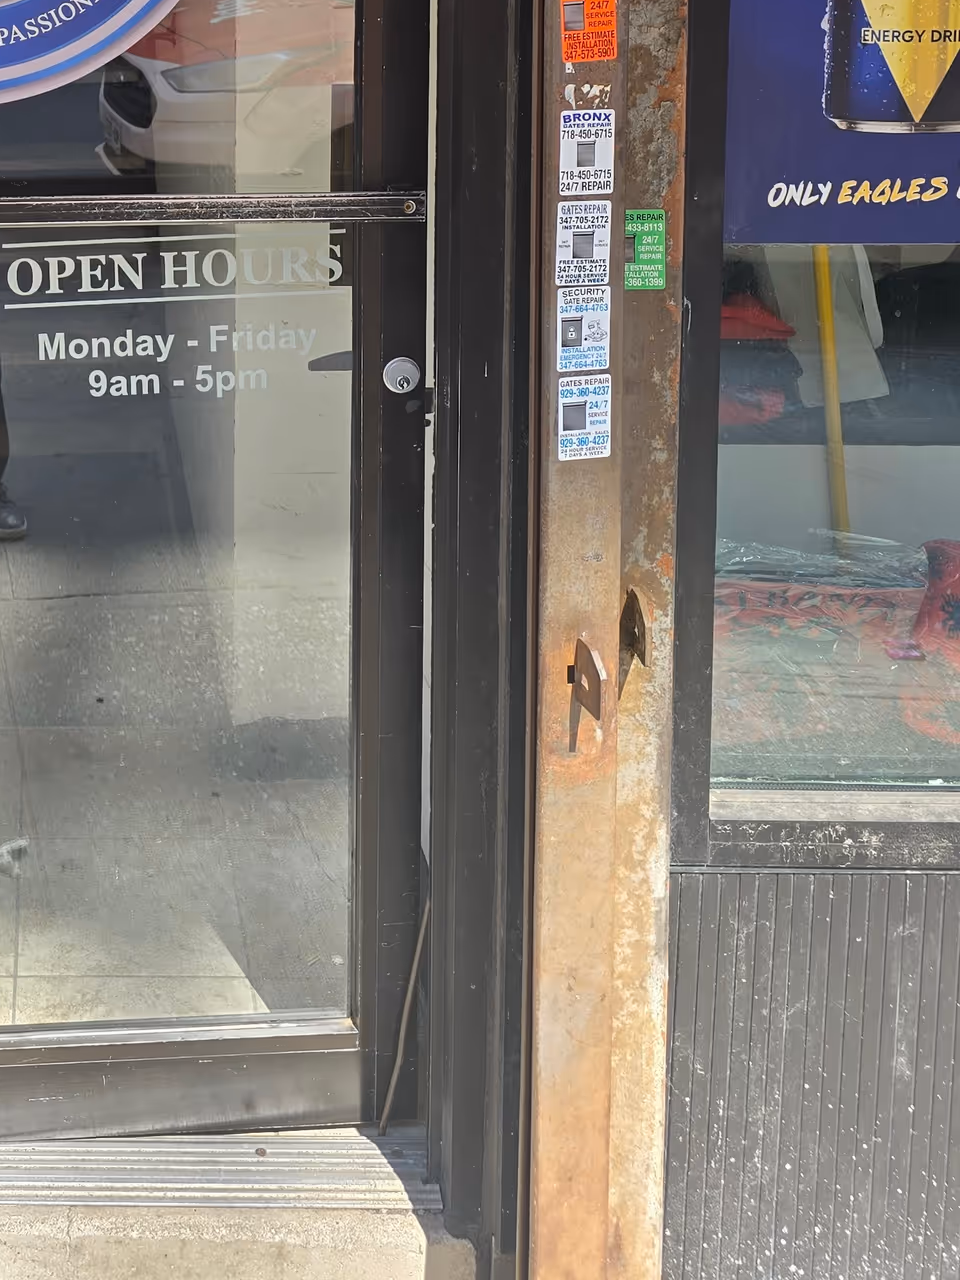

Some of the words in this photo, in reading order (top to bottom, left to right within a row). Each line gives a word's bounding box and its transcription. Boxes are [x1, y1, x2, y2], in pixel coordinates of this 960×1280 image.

[591, 1, 609, 9] 24/7
[586, 11, 614, 19] SERVICE
[564, 33, 580, 41] FREE
[583, 30, 614, 40] ESTIMATE
[863, 30, 926, 42] ENERGY
[567, 39, 612, 50] INSTALLATION
[564, 47, 614, 60] 347-573-5901
[563, 113, 612, 123] BRONX
[562, 129, 612, 139] 718-450-6715
[561, 169, 611, 180] 718-450-6715
[561, 182, 579, 192] 24/7
[582, 181, 611, 191] REPAIR
[768, 180, 832, 207] ONLY
[838, 177, 948, 205] EAGLES
[562, 205, 582, 214] GATES
[584, 204, 607, 214] REPAIR
[559, 216, 609, 224] 347-705-2172
[7, 253, 147, 296] OPEN
[160, 244, 342, 288] HOURS
[558, 265, 607, 273] 347-705-2172
[562, 289, 606, 298] SECURITY
[560, 304, 608, 313] 347-664-4763
[38, 329, 174, 362] Monday
[210, 322, 317, 355] Friday
[559, 359, 607, 369] 347-664-4763
[89, 370, 160, 397] 9am
[195, 365, 267, 398] 5pm
[560, 386, 609, 398] 929-360-4237
[589, 400, 608, 409] 24/7
[560, 435, 609, 448] 929-360-4237
